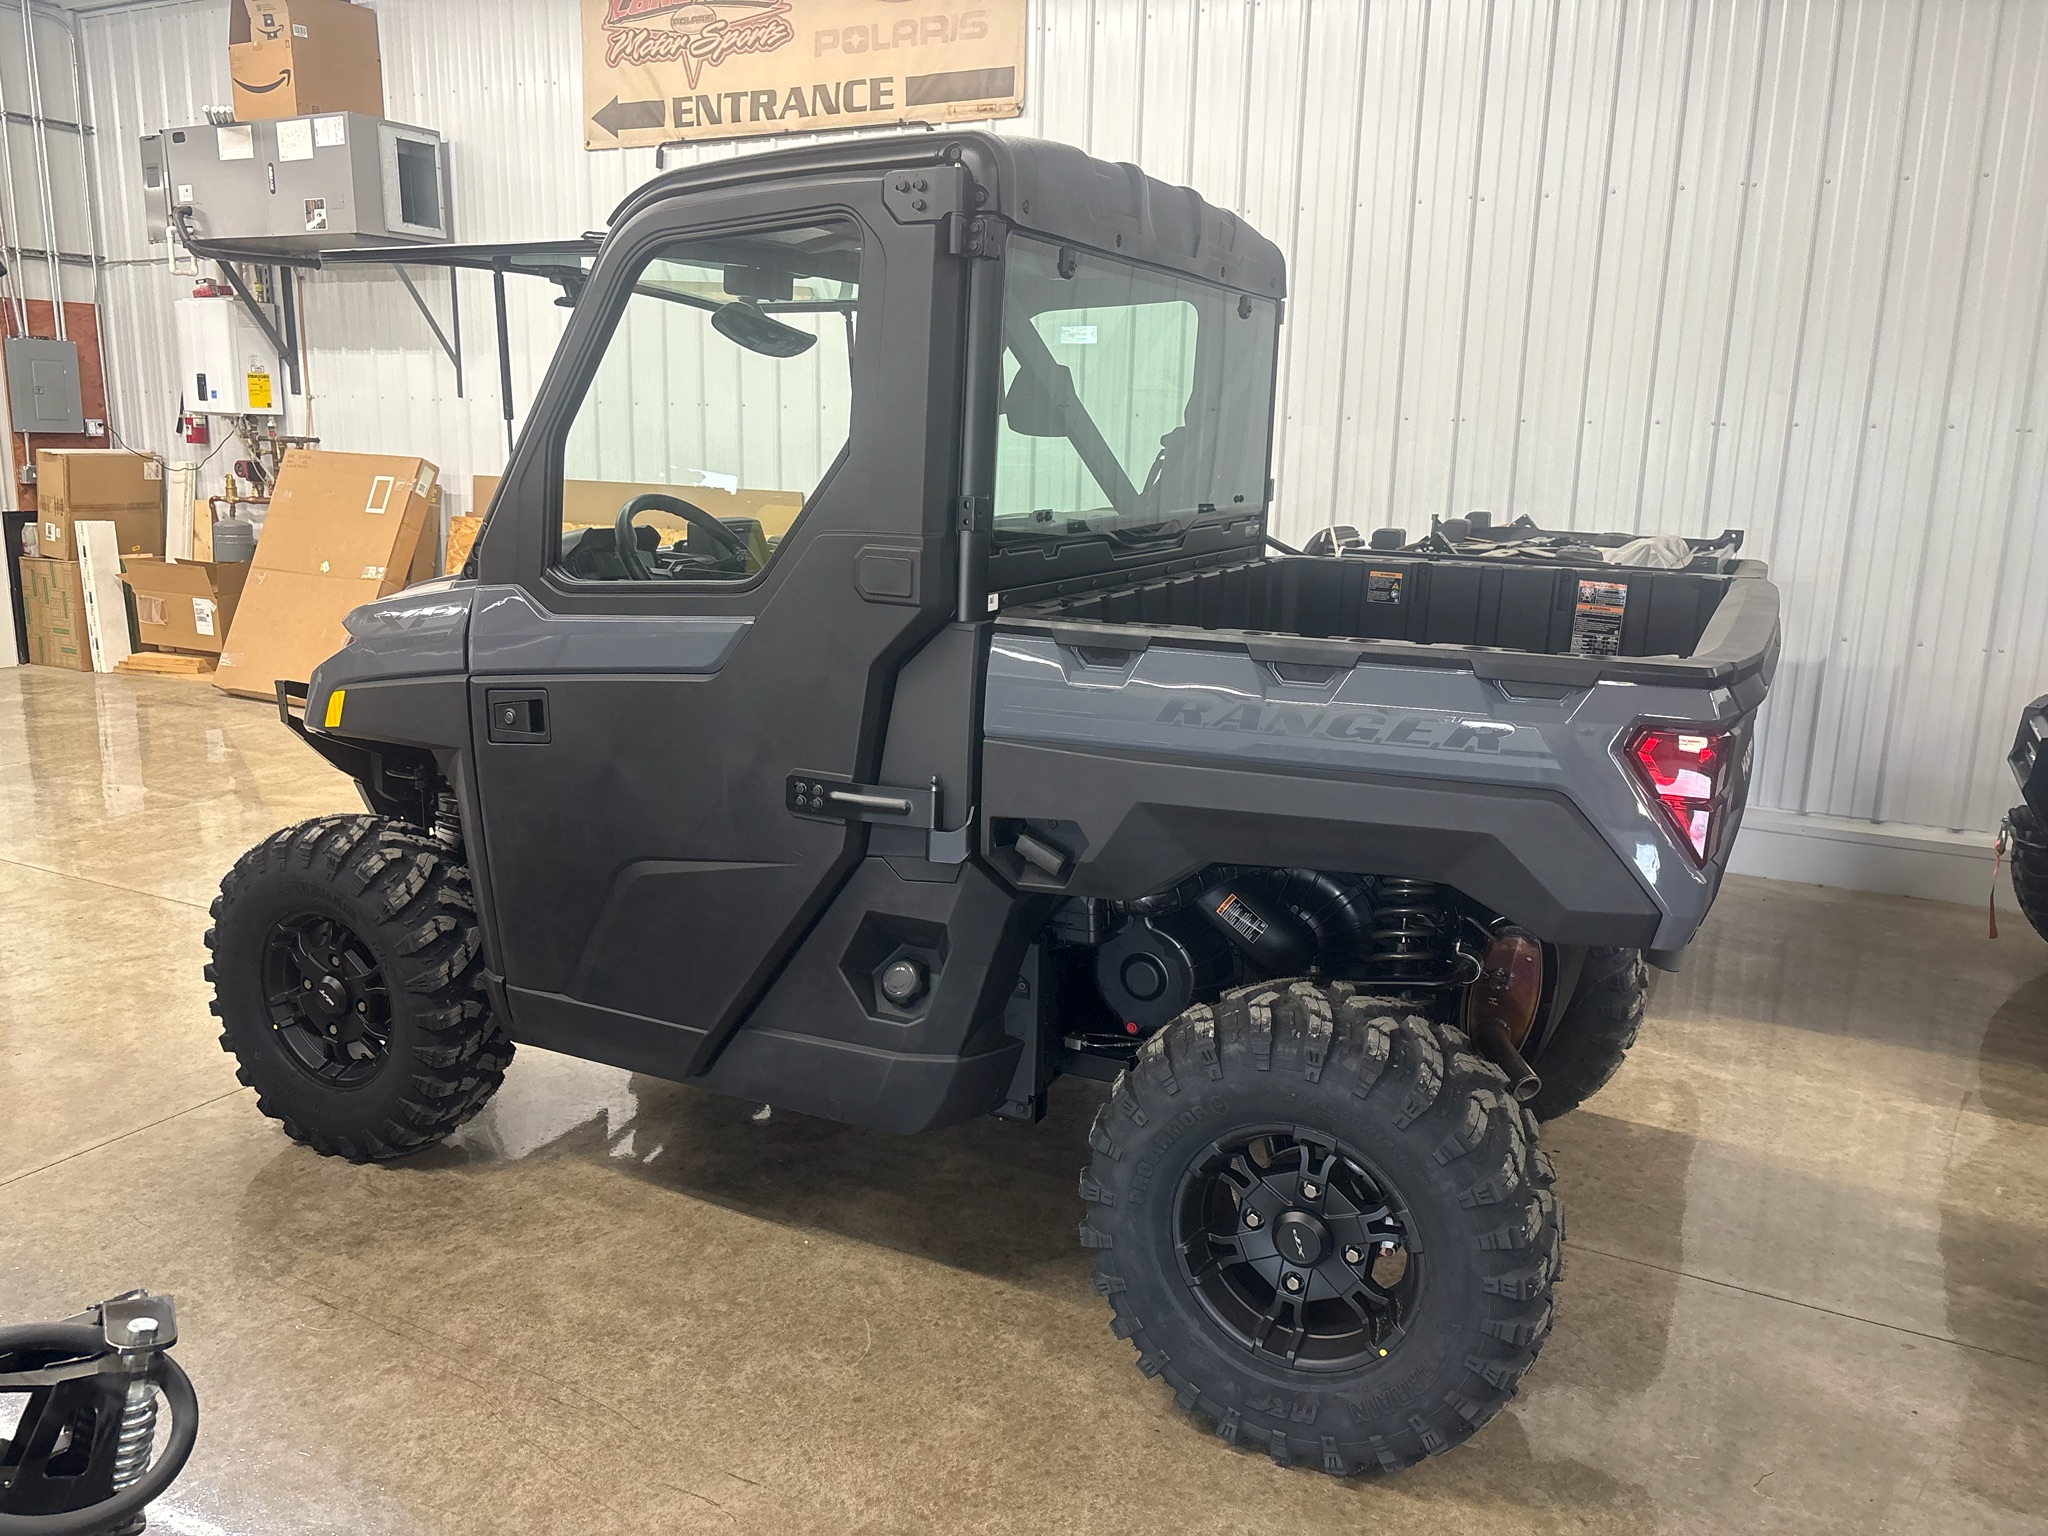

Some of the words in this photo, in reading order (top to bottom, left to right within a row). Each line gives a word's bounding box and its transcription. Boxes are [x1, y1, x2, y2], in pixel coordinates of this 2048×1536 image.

[609, 28, 691, 63] Motor
[689, 19, 789, 63] Sports
[814, 10, 988, 58] POLARIS
[672, 76, 895, 128] ENTRANCE
[1154, 697, 1516, 753] RANGER
[1152, 1104, 1209, 1165] ARMOR
